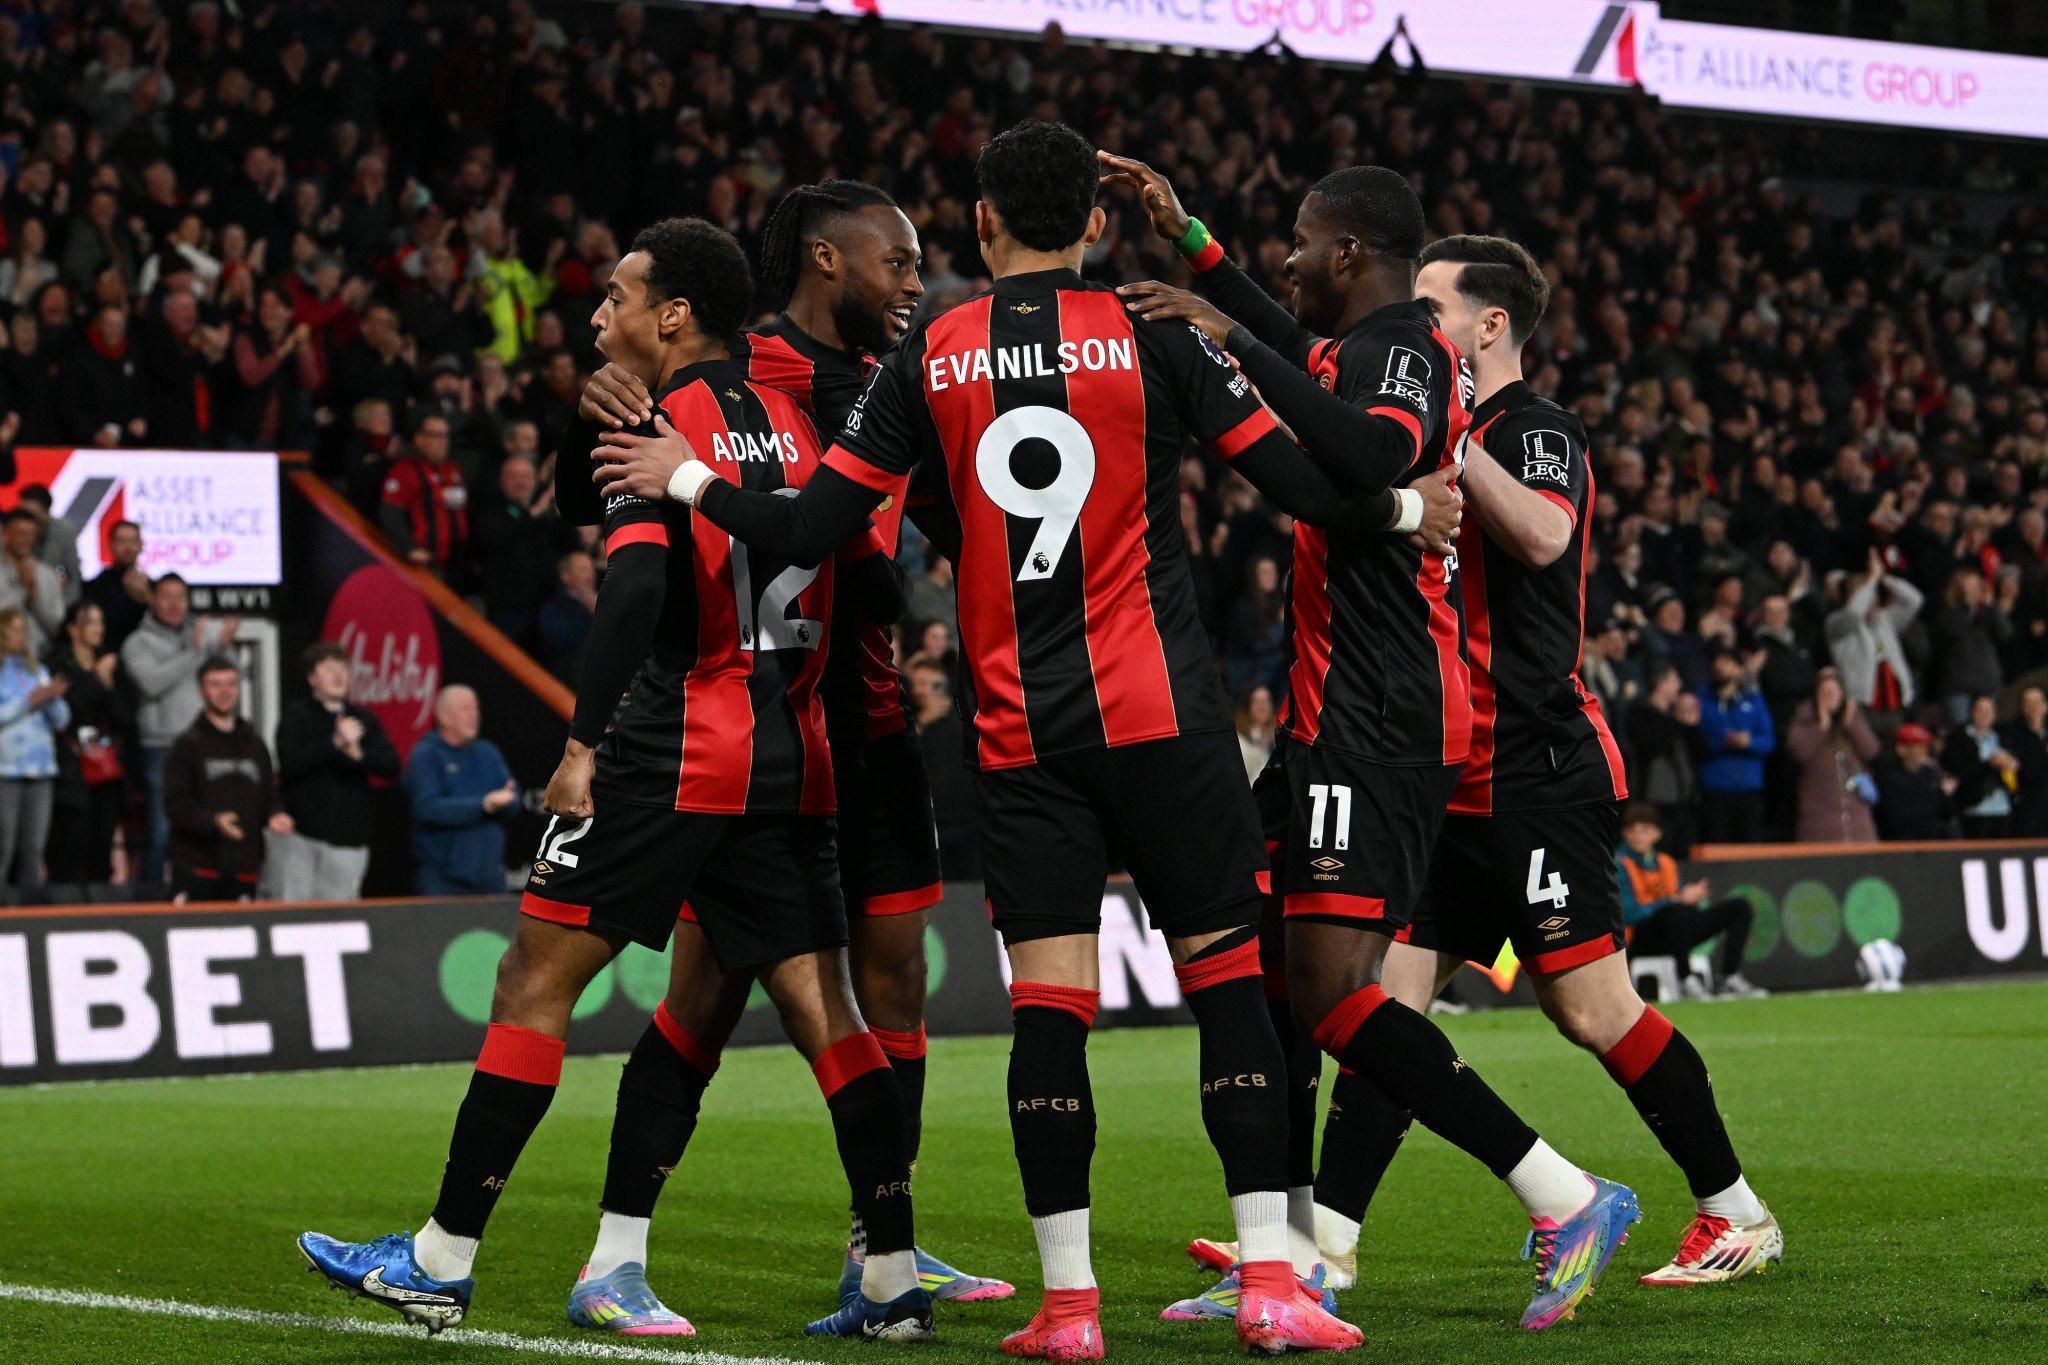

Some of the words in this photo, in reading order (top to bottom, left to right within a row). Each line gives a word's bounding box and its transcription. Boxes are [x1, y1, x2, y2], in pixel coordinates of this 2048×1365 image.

[1695, 46, 1853, 99] ALLIANCE
[1862, 62, 1980, 109] GROUP
[928, 337, 1132, 393] EVANILSON
[1377, 381, 1428, 412] LEOS
[711, 431, 799, 464] ADAMS
[132, 476, 213, 505] ASSET
[1522, 464, 1569, 487] LEOS
[975, 405, 1096, 582] 9
[729, 487, 824, 651] 12
[1309, 784, 1351, 850] 11
[536, 814, 594, 869] 12
[1313, 872, 1339, 881] umbro
[1526, 847, 1569, 909] 4
[1544, 928, 1570, 942] umbro
[1202, 1073, 1267, 1096] AFCB
[1016, 1097, 1081, 1113] AFCB
